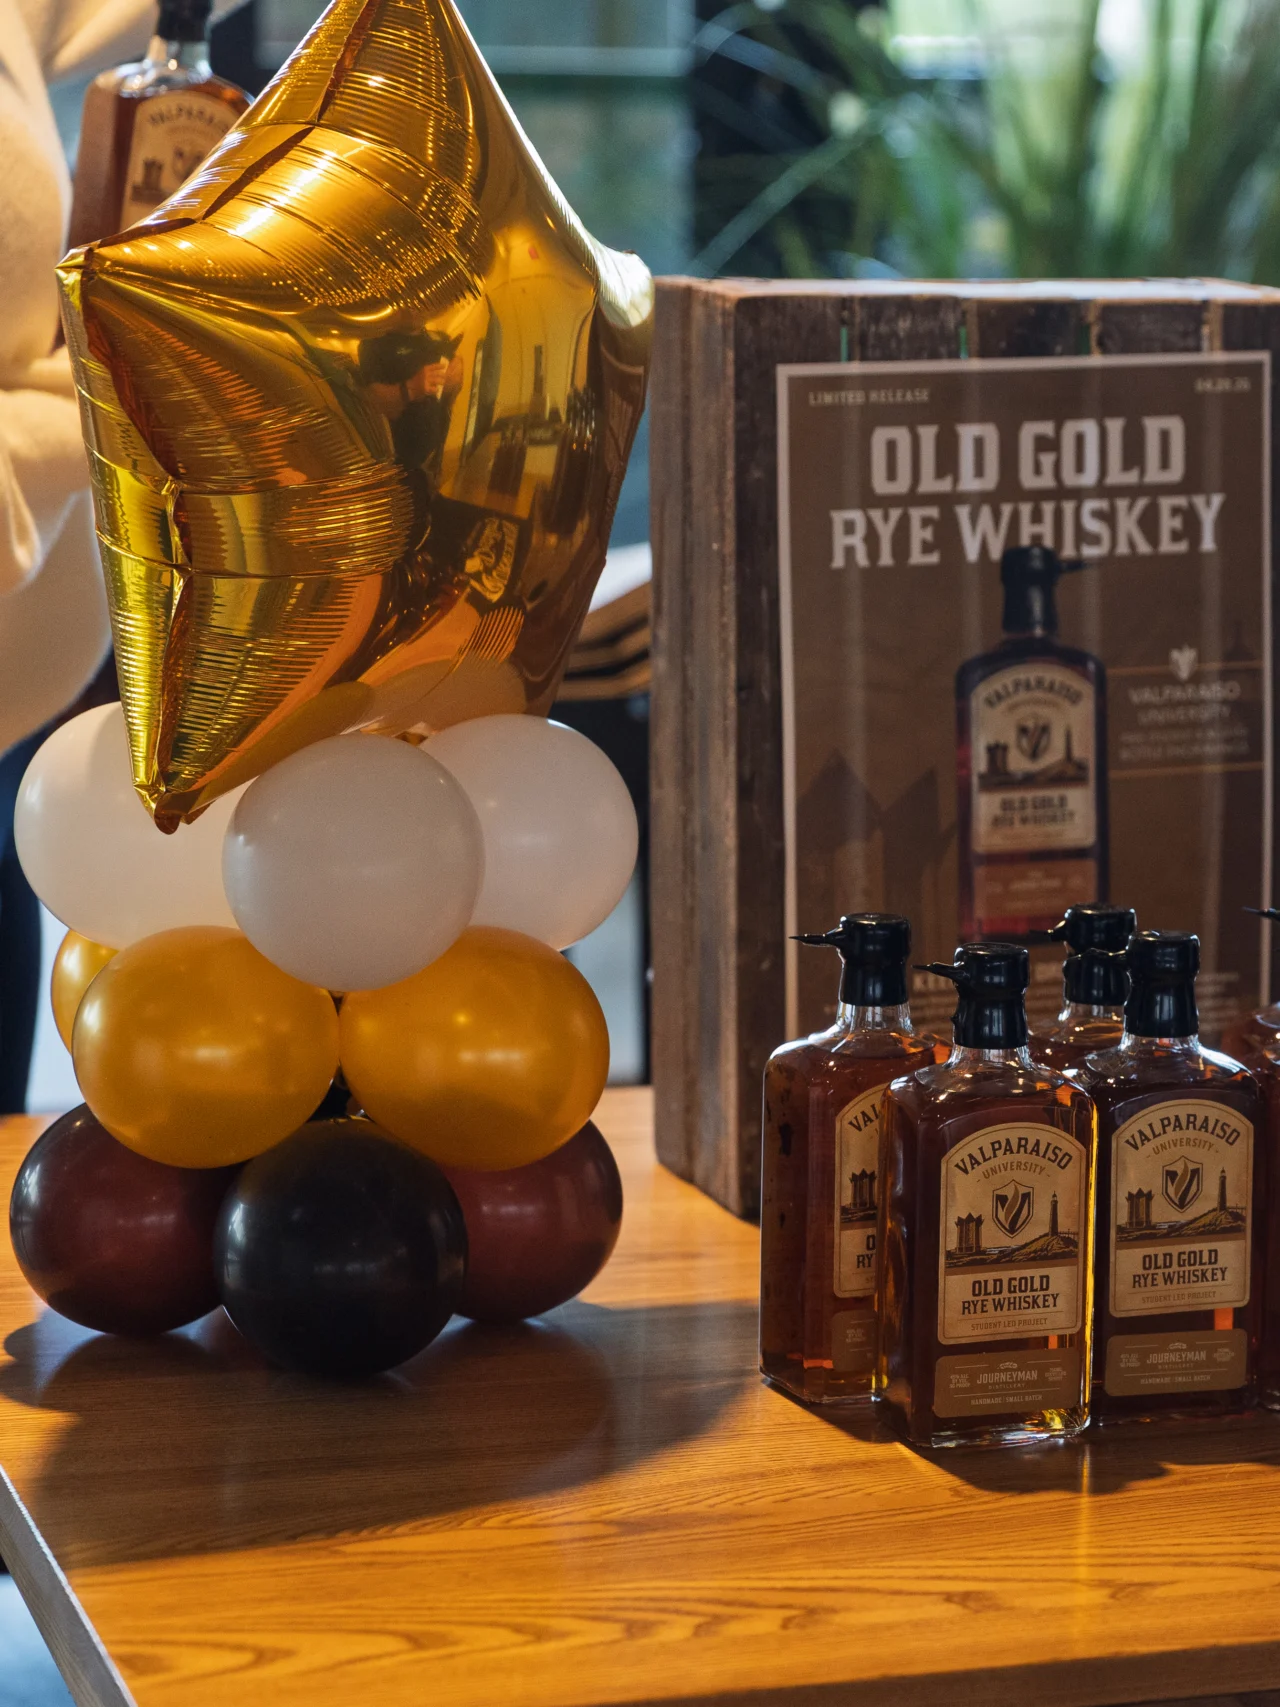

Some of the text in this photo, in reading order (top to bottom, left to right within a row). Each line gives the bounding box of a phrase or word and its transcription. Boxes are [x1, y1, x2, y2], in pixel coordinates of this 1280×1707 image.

[808, 387, 930, 406] LIMITED RELEASE
[870, 414, 1186, 496] OLD GOLD
[830, 493, 1227, 570] RYE WHISKEY
[1124, 1113, 1242, 1151] VALPARAISO
[954, 1136, 1073, 1175] VALPARAISO
[1152, 1137, 1215, 1156] UNIVERSITY
[982, 1160, 1046, 1180] UNIVERSITY
[1142, 1249, 1219, 1271] OLD GOLD
[972, 1274, 1050, 1297] OLD GOLD
[1132, 1266, 1228, 1289] RYE WHISKEY
[962, 1293, 1060, 1315] RYE WHISKEY
[1141, 1290, 1217, 1304] STUDENT LED PROJECT
[971, 1318, 1048, 1331] STUDENT LED PROJECT
[1146, 1350, 1207, 1364] JOURNEYMAN
[976, 1369, 1038, 1385] JOURNEYMAN
[1140, 1374, 1211, 1385] HANDMADE SMALL BATCH
[971, 1394, 1043, 1405] HANDMADE SMALL BATCH
